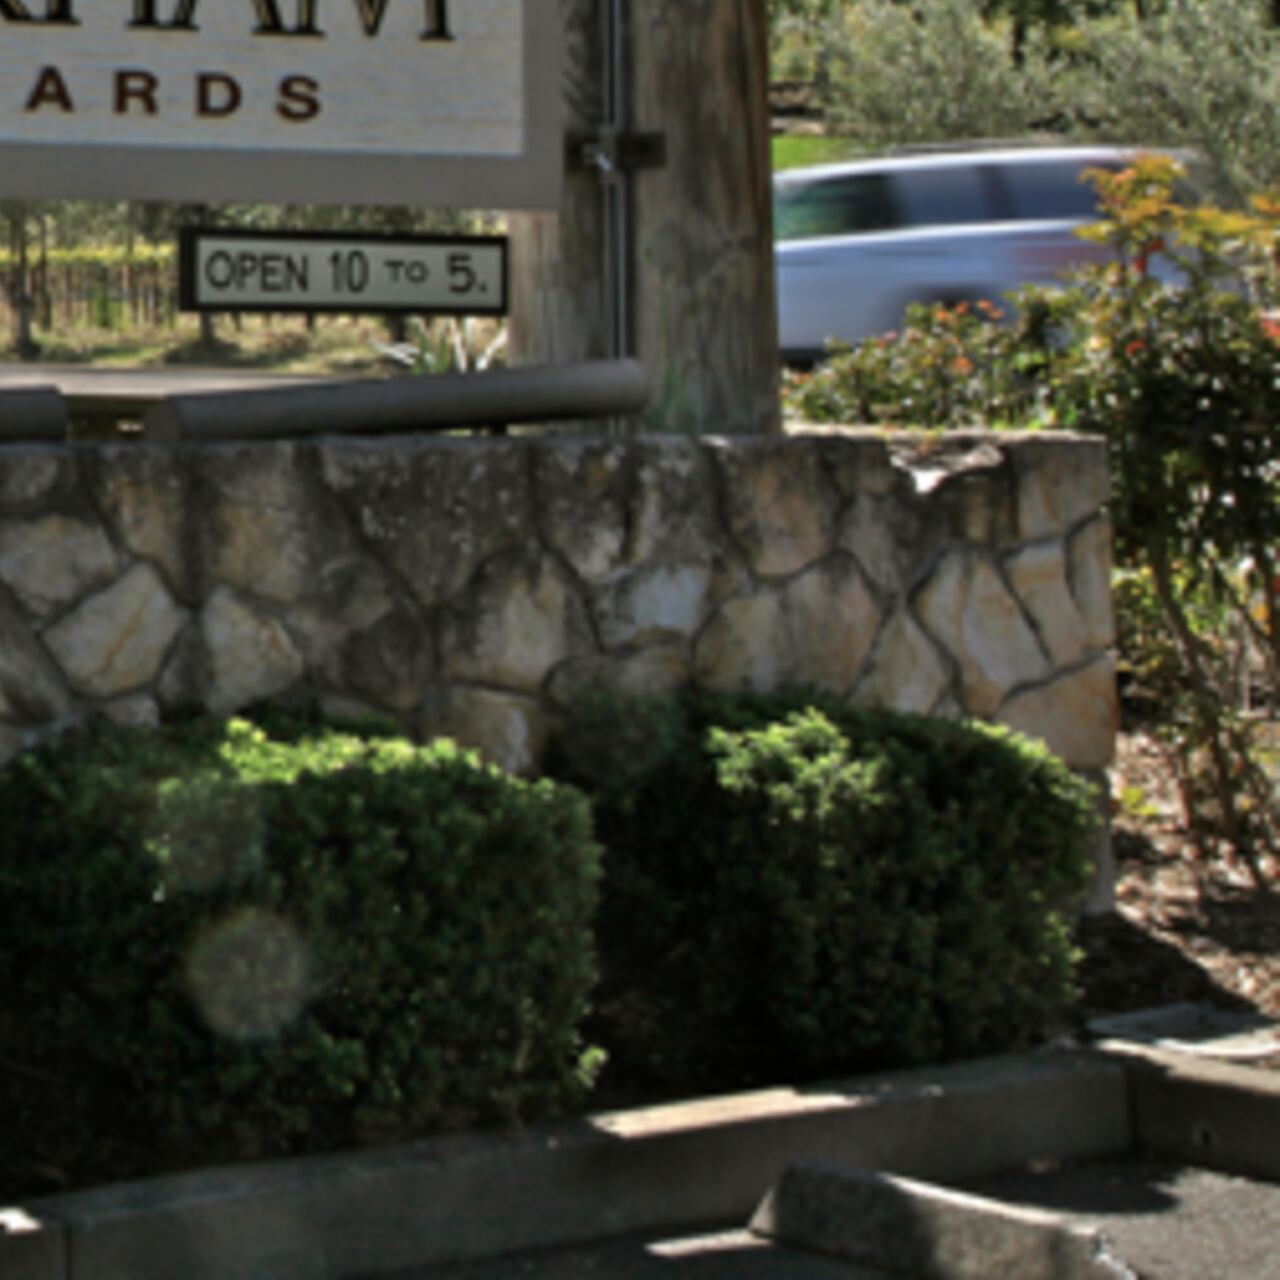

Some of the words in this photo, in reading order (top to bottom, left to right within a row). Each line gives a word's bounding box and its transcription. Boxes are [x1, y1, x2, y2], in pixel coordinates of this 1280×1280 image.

[204, 249, 310, 294] OPEN
[327, 250, 370, 294] 10
[384, 260, 430, 286] TO
